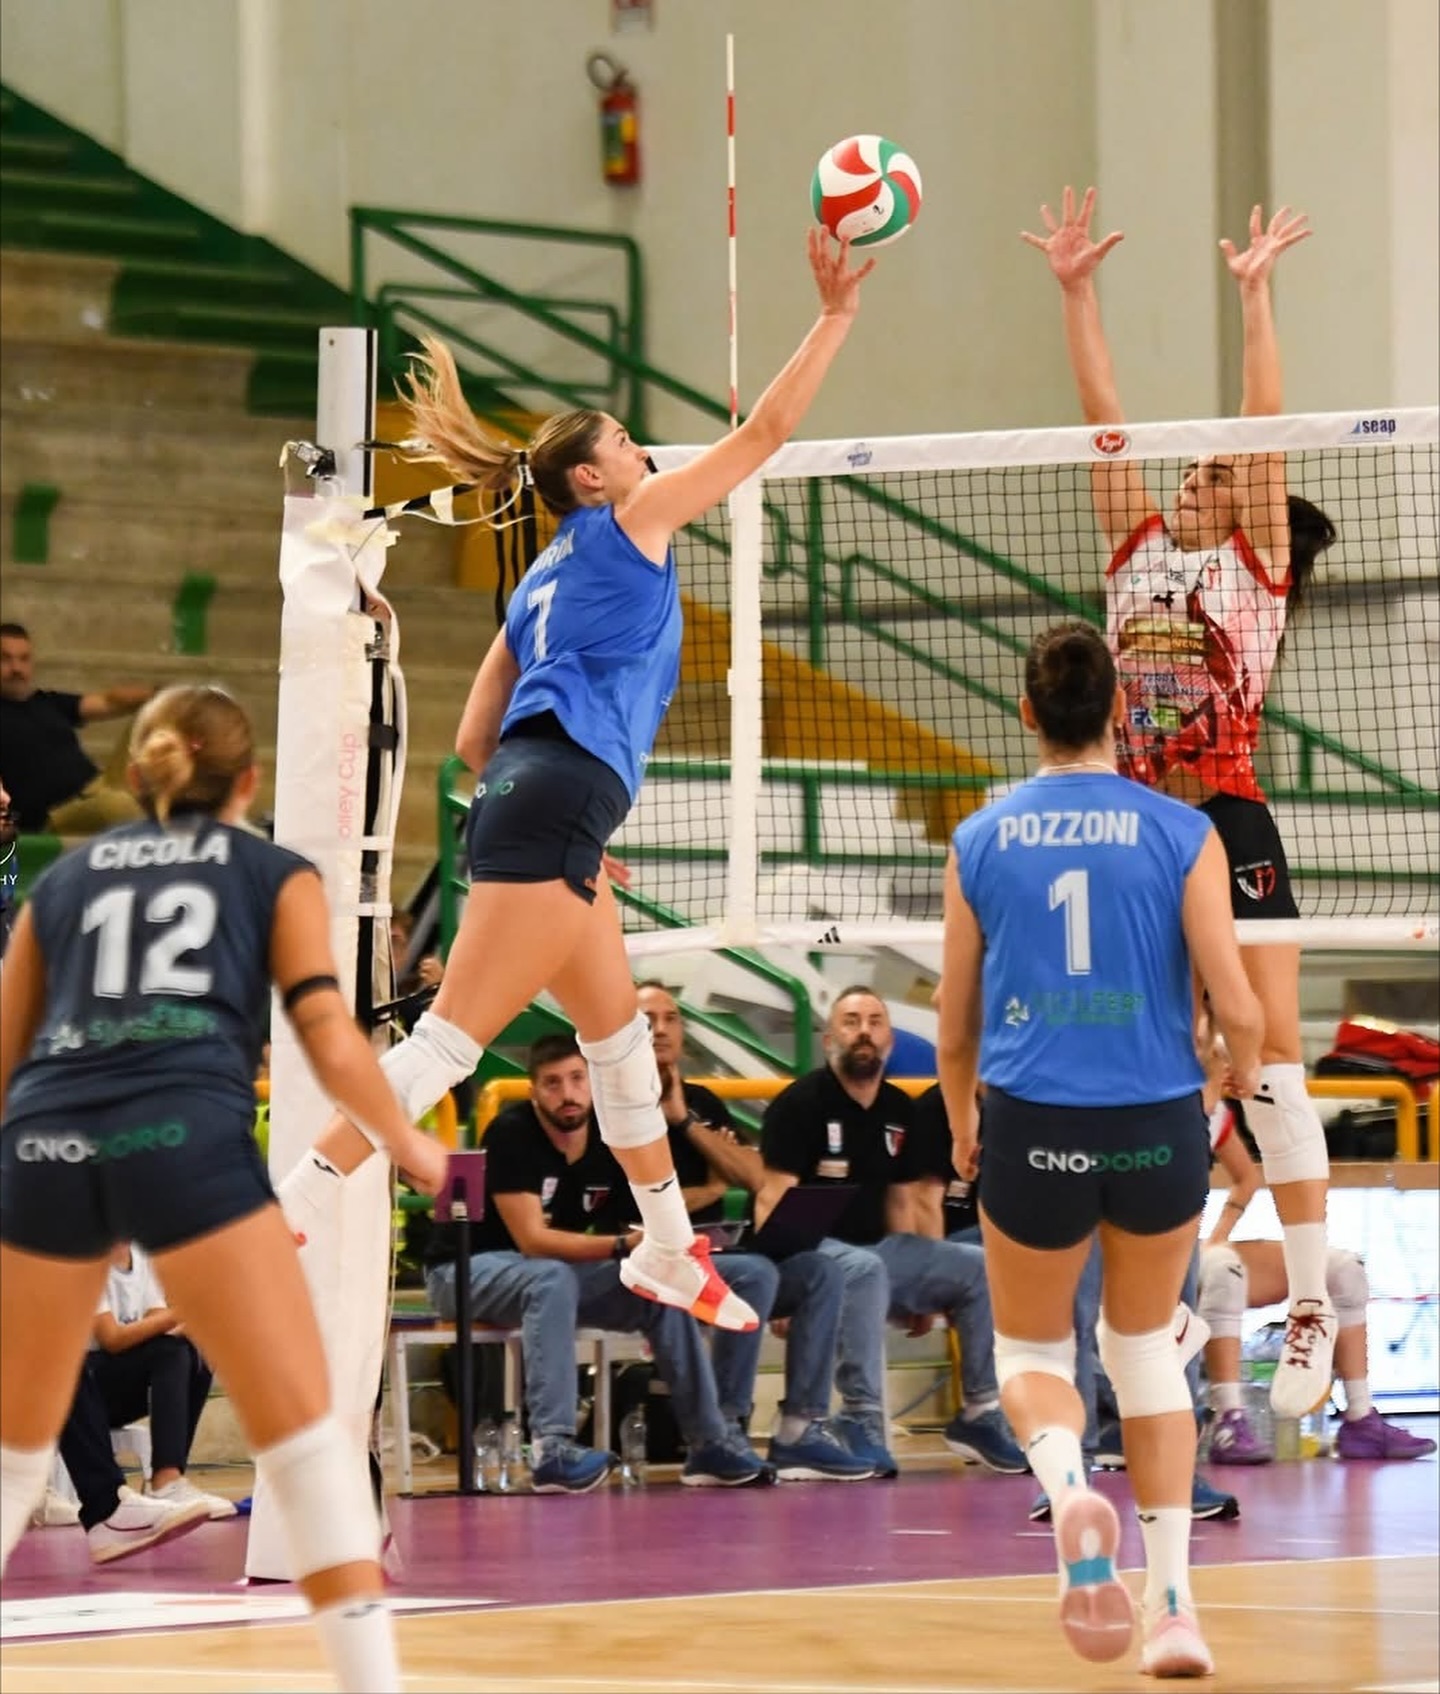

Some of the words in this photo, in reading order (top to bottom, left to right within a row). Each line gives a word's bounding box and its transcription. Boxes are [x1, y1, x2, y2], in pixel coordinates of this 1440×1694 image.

[1361, 418, 1396, 438] seap
[527, 579, 558, 663] 7
[338, 733, 363, 780] Cup
[338, 786, 361, 840] olley
[998, 810, 1139, 851] POZZONI
[88, 831, 231, 871] CICOLA
[80, 882, 217, 999] 12
[1047, 869, 1092, 976] 1
